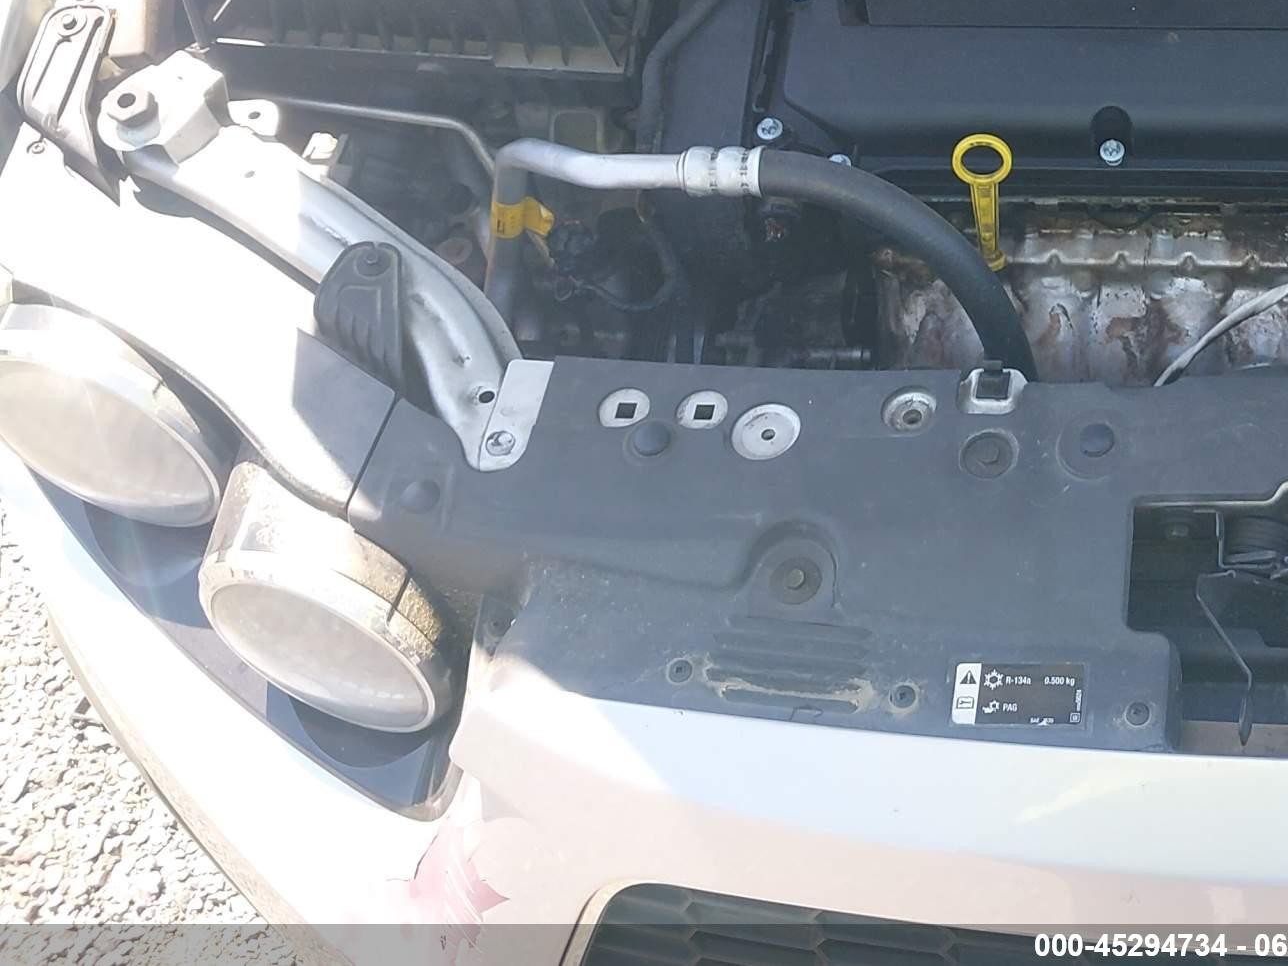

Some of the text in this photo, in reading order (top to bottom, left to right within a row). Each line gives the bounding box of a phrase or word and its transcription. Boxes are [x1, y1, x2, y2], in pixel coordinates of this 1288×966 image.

[1005, 676, 1075, 687] R-134a 0.500 kg
[1002, 703, 1018, 712] PAG
